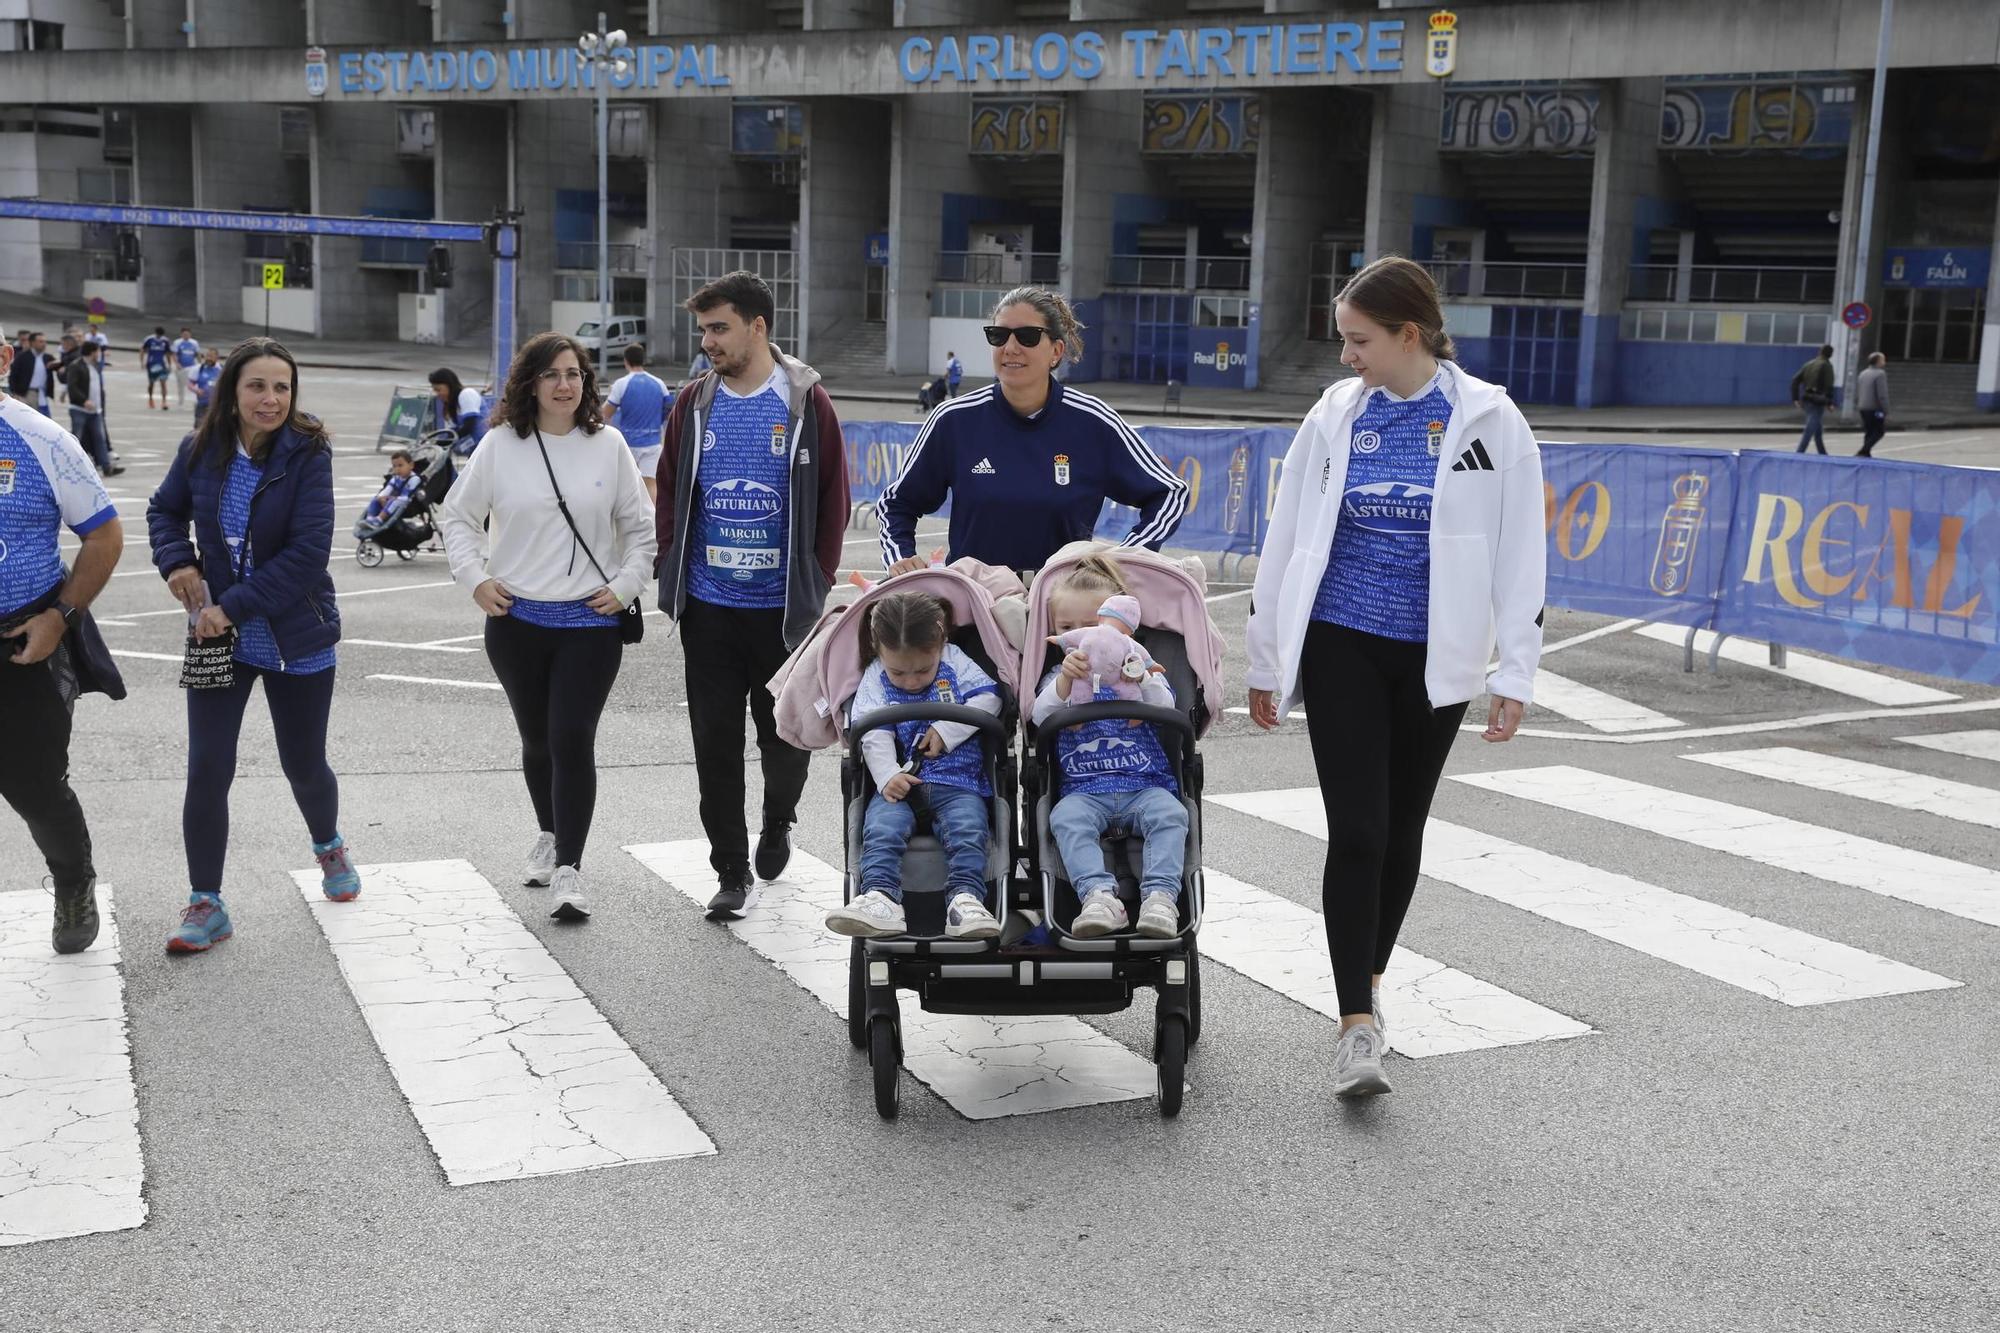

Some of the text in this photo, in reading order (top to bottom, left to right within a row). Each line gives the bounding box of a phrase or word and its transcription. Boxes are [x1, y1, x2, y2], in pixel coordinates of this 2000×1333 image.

[900, 31, 1103, 83] CARLOS
[1124, 20, 1405, 78] TARTIERE
[338, 43, 732, 93] ESTADIO MUNCIPAL
[121, 209, 152, 221] 1926
[277, 217, 308, 231] 2026
[1943, 252, 1953, 266] 6
[266, 268, 281, 285] P2
[1927, 263, 1967, 279] FALÍN
[1194, 352, 1215, 364] Real
[719, 527, 768, 539] MARCHA
[737, 552, 775, 566] 2758
[1742, 492, 1984, 619] REAL
[190, 664, 229, 674] BUDAPEST
[1066, 751, 1149, 773] ASTURIANA
